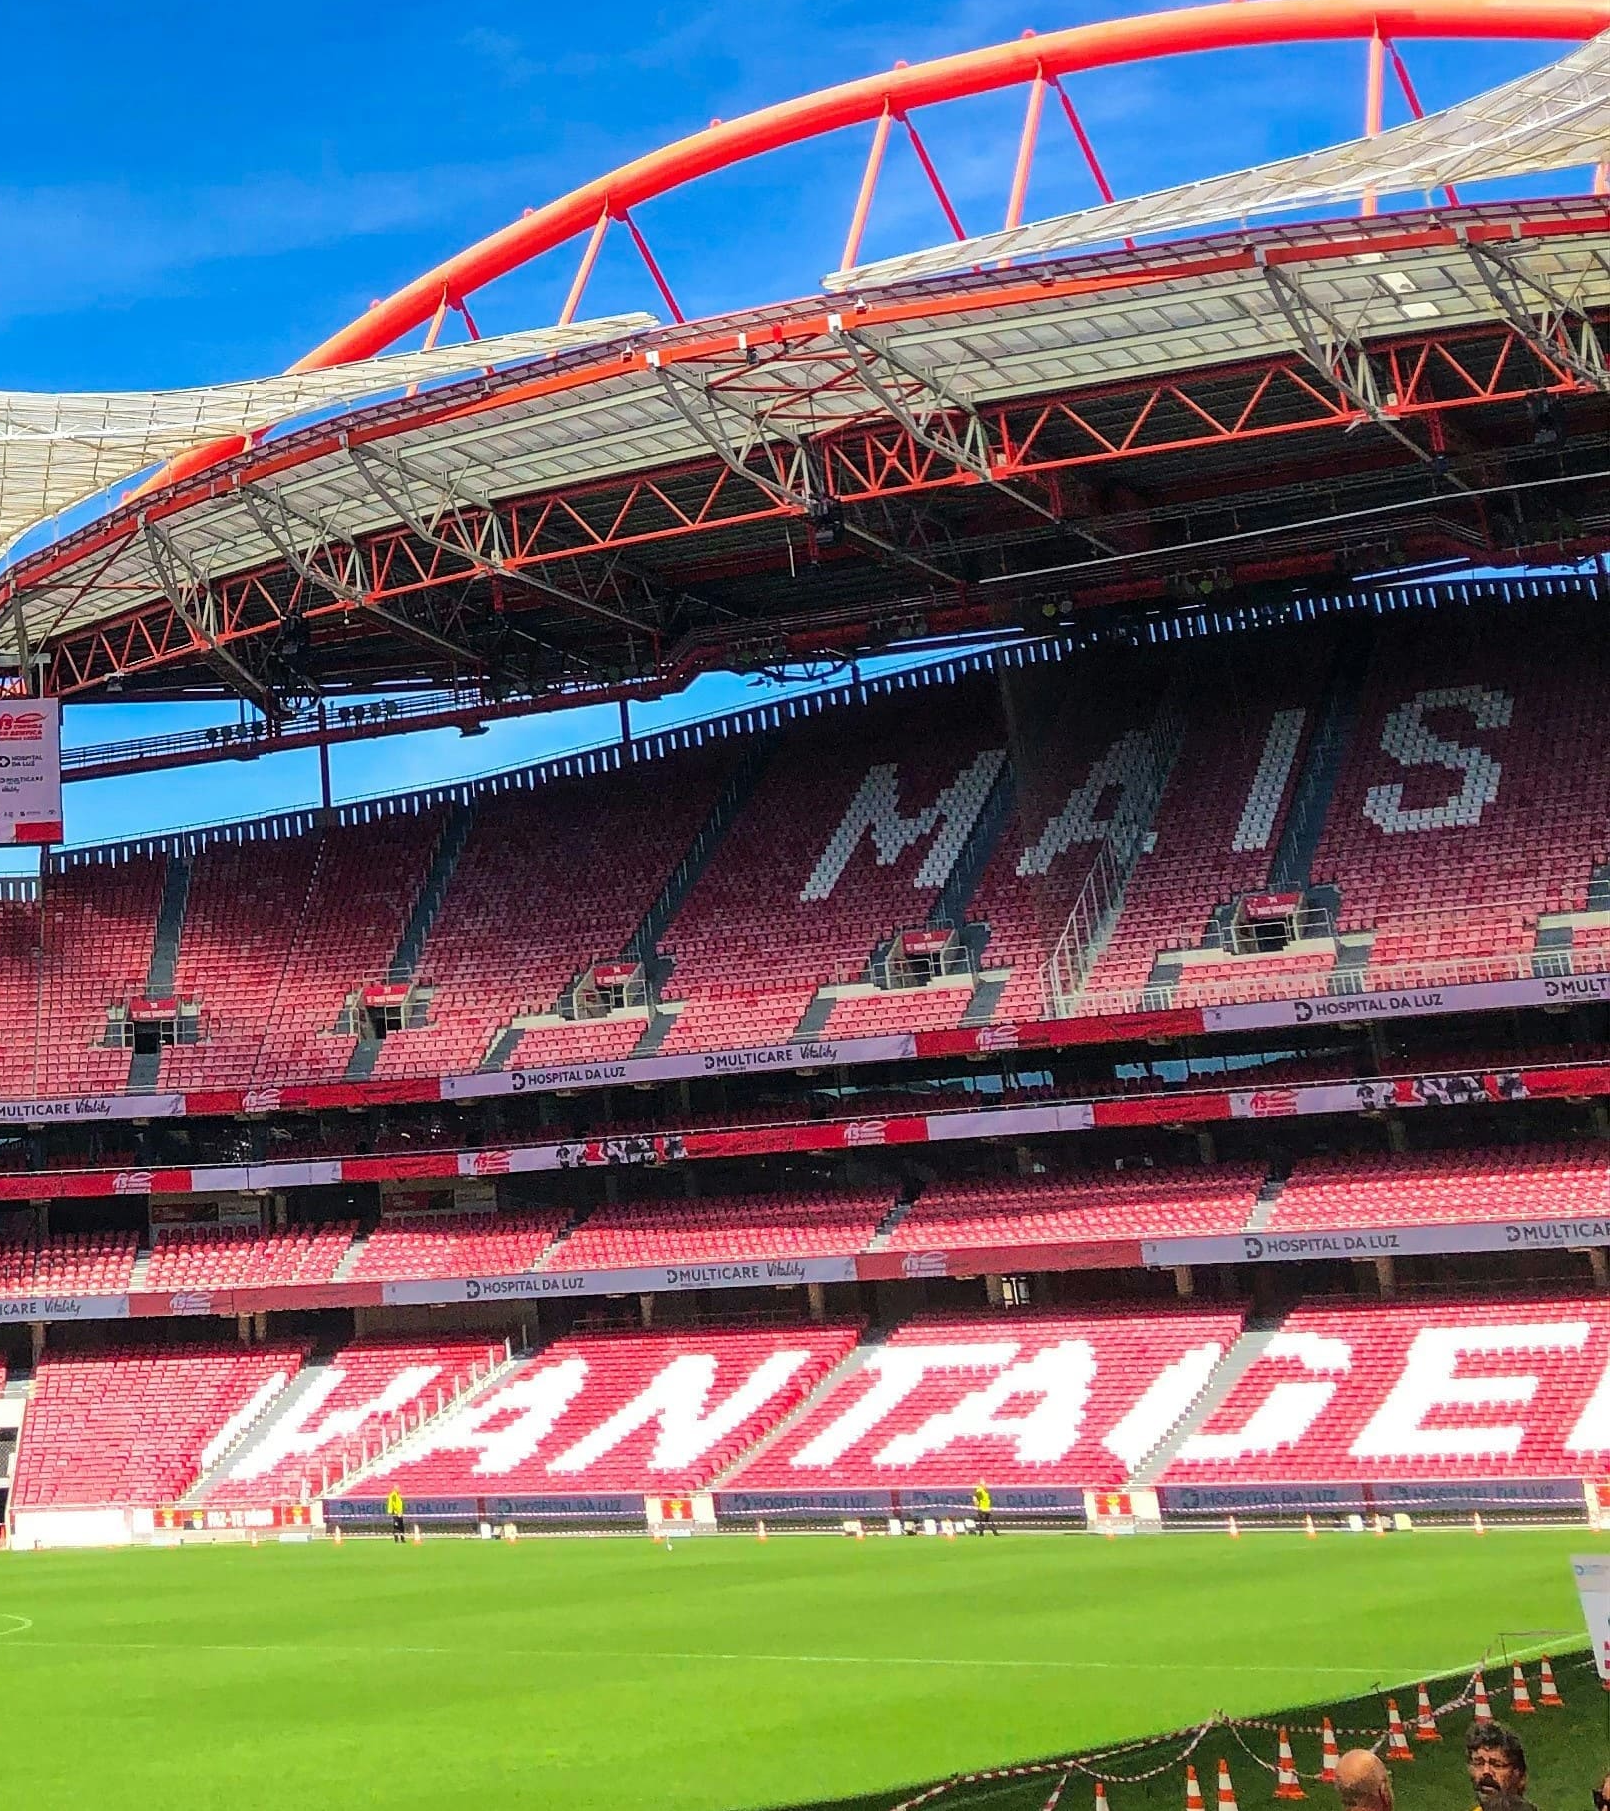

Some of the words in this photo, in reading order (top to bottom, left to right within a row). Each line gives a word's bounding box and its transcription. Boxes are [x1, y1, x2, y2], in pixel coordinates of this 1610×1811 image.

[800, 685, 1515, 901] MAIS
[1316, 999, 1387, 1016] HOSPITAL
[1390, 997, 1411, 1009] DA
[1414, 994, 1443, 1007] LUZ
[716, 1049, 792, 1067] MULTICARE
[528, 1071, 583, 1085] HOSPITAL
[585, 1069, 601, 1079] DA
[604, 1067, 626, 1078] LUZ
[1267, 1238, 1341, 1252] HOSPITAL
[1344, 1237, 1366, 1250] DA
[1370, 1235, 1400, 1248] LUZ
[680, 1266, 759, 1281] MULTICARE
[483, 1280, 540, 1293] HOSPITAL
[542, 1279, 559, 1290] DA
[562, 1278, 585, 1289] LUZ
[200, 1320, 1610, 1482] VANTAGE
